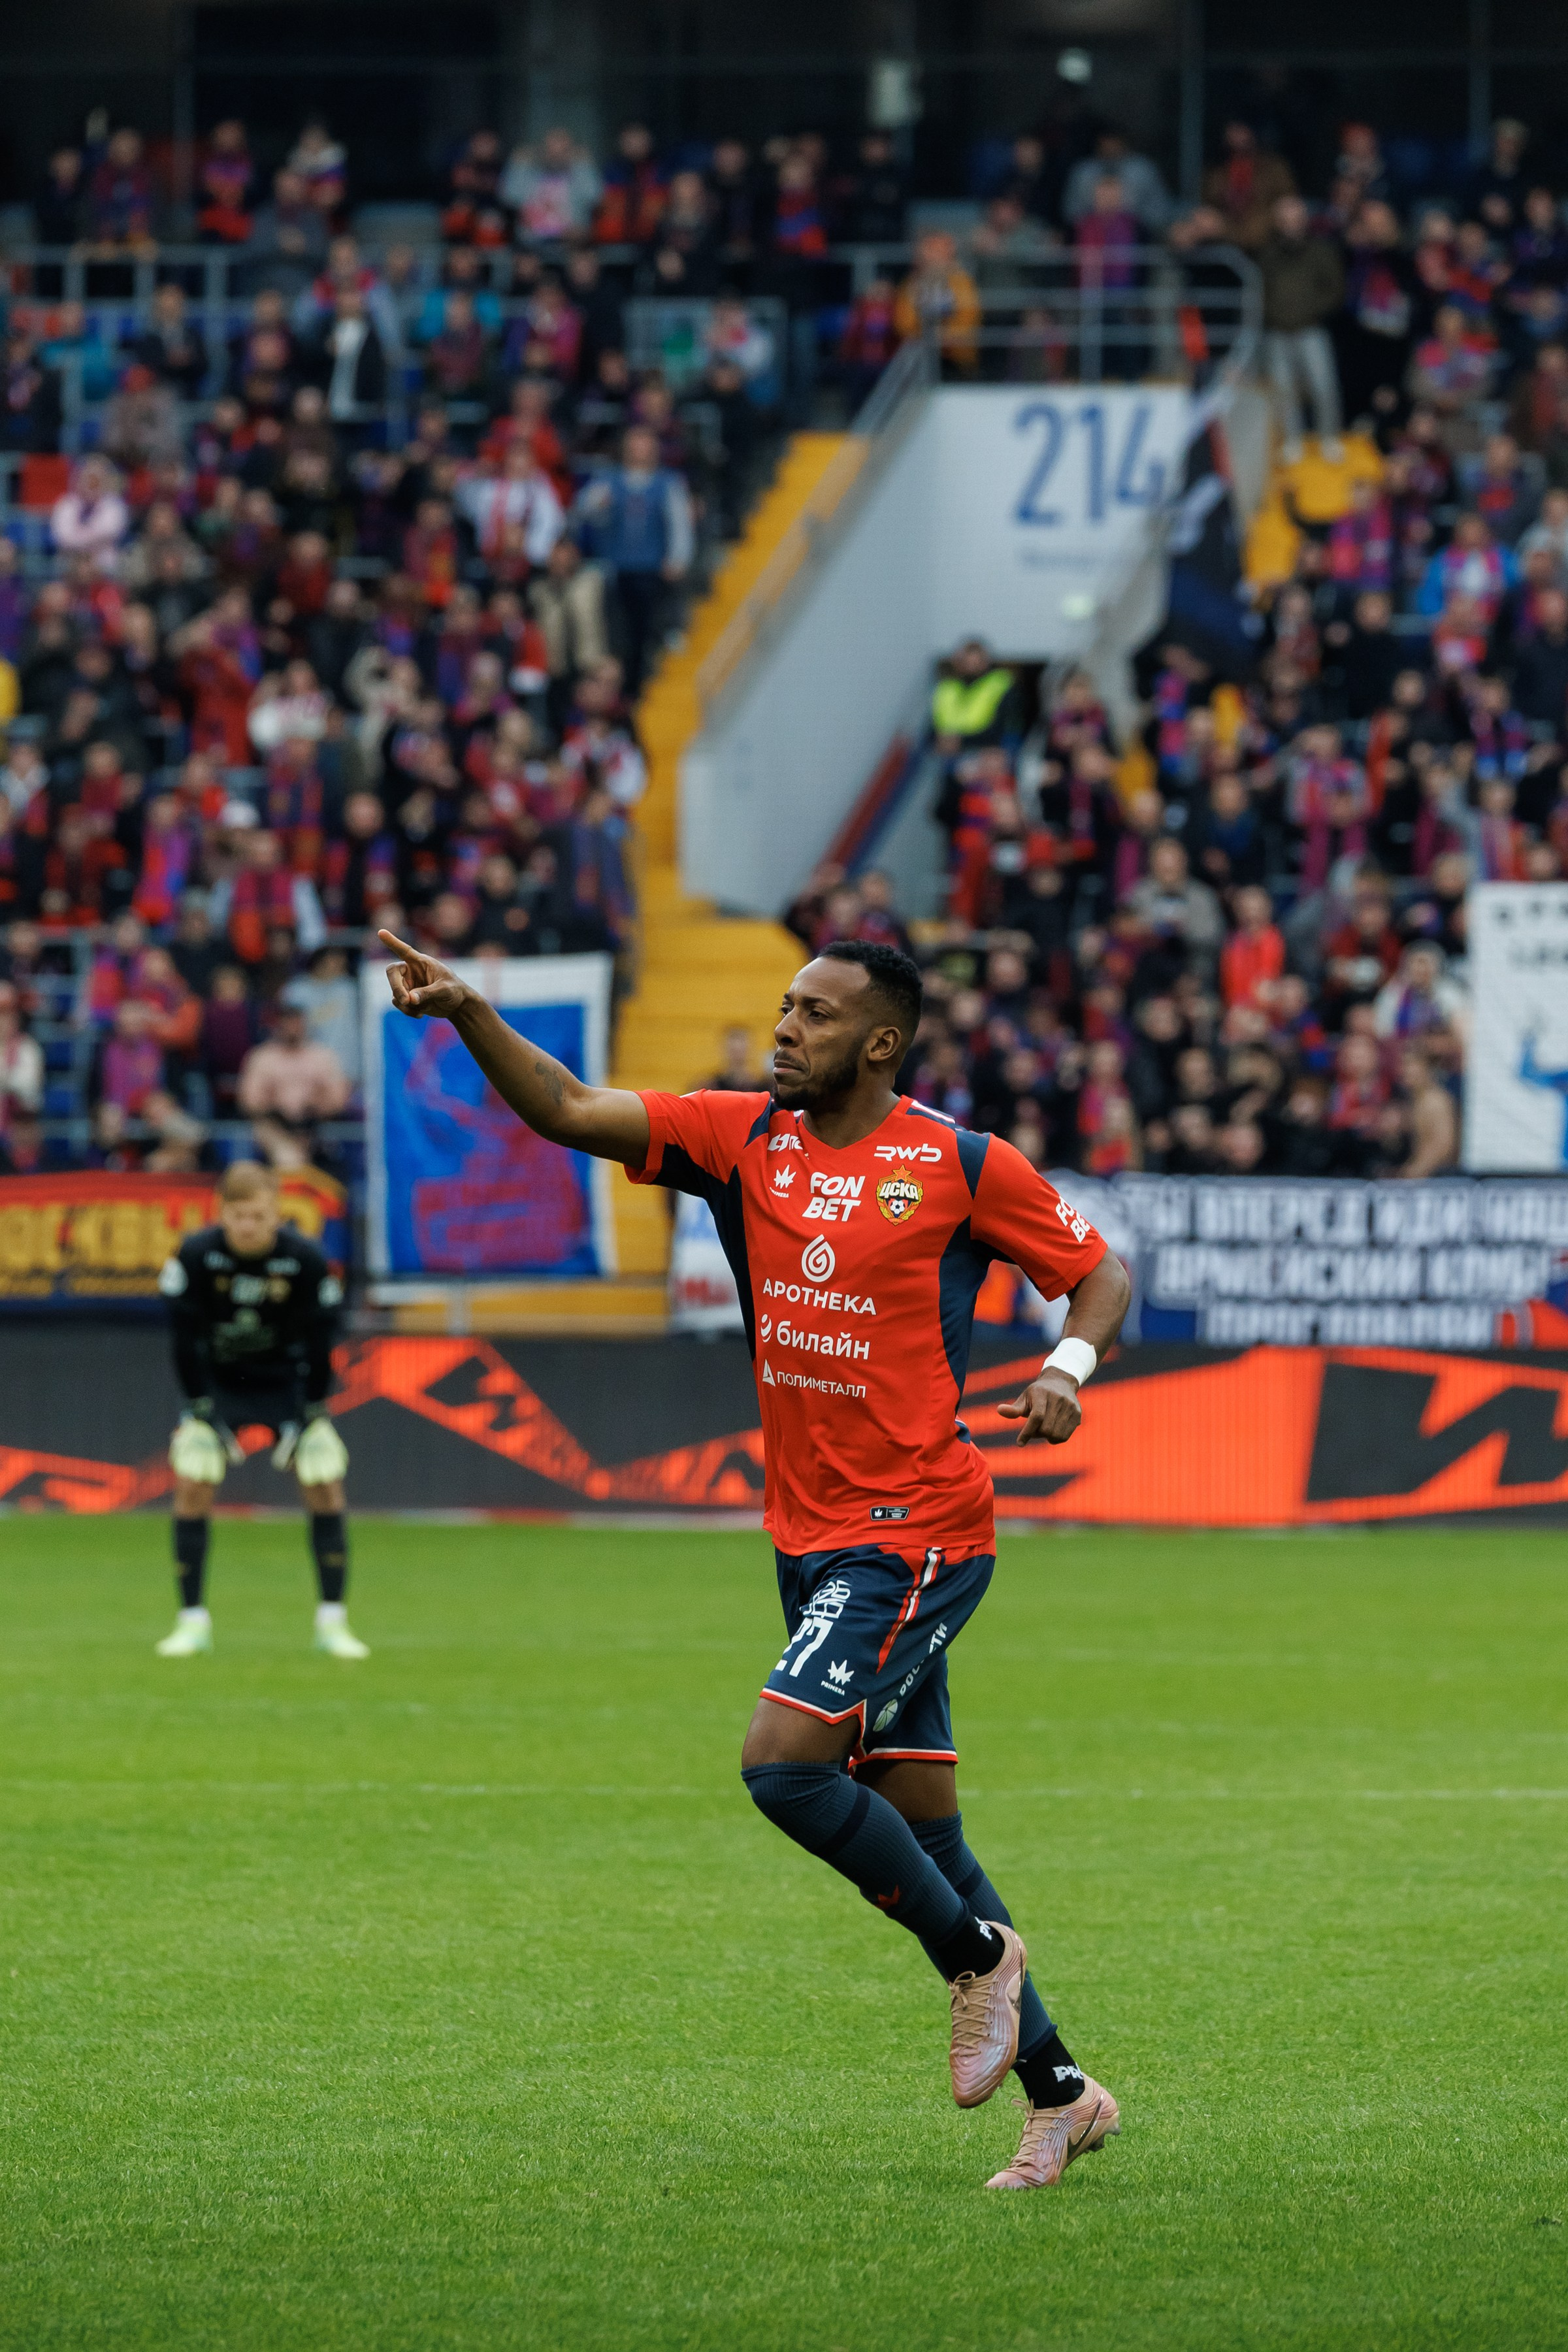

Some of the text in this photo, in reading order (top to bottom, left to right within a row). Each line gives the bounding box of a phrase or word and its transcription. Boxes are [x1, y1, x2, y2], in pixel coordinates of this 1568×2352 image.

[1012, 400, 1167, 527] 214
[810, 1171, 866, 1198] FON
[879, 1182, 919, 1200] ЦСКА
[802, 1197, 862, 1222] BET
[1055, 1196, 1075, 1227] FO
[1070, 1212, 1090, 1243] BE
[762, 1278, 877, 1315] APOTHEKA
[777, 1320, 870, 1360] билайн
[777, 1371, 866, 1398] ПОЛИМЕТАЛЛ
[775, 1616, 834, 1678] 27
[821, 1680, 845, 1696] PRIMERA
